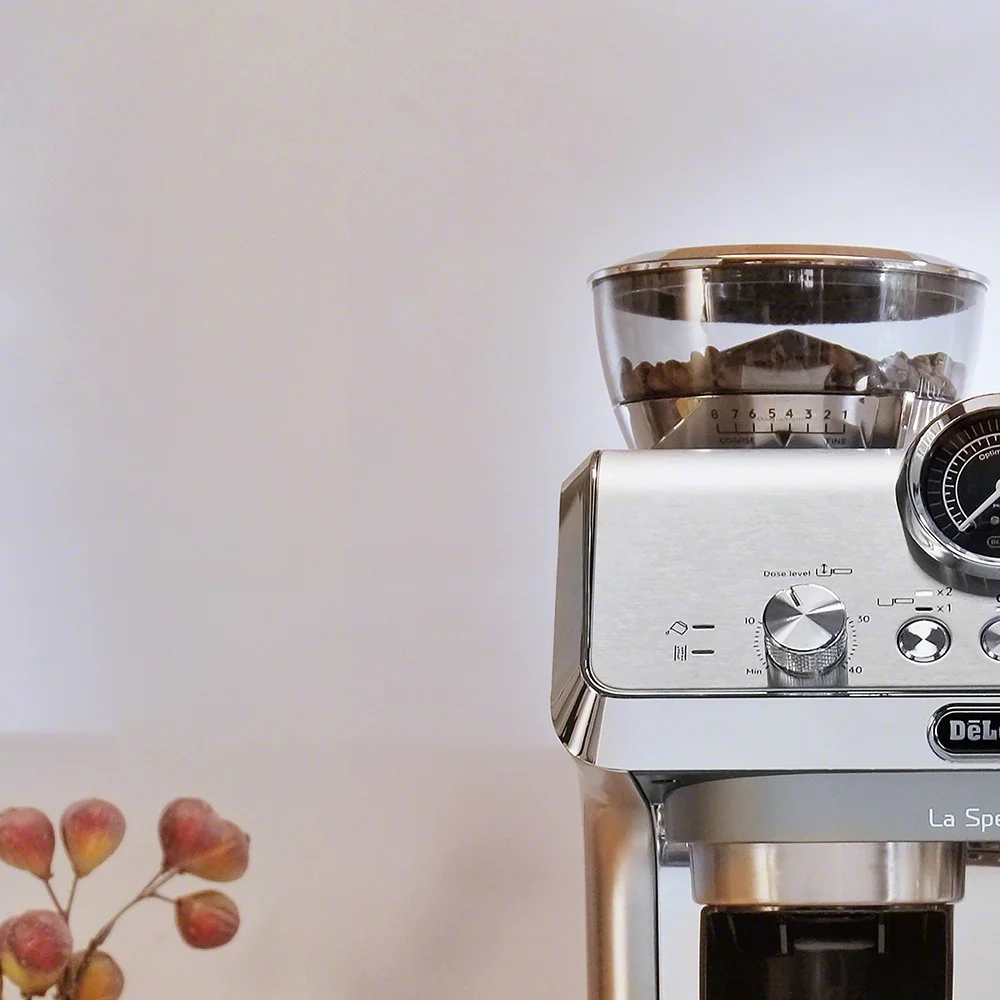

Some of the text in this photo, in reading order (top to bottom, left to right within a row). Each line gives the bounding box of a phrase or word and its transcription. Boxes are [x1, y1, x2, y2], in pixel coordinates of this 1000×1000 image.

[711, 409, 719, 420] 8
[731, 409, 738, 419] 7
[749, 408, 756, 419] 6
[769, 408, 776, 419] 5
[785, 409, 793, 419] 4
[805, 409, 812, 420] 3
[824, 410, 831, 420] 2
[744, 616, 755, 625] 10
[858, 615, 870, 623] 30
[848, 666, 862, 674] 40
[928, 808, 955, 828] La
